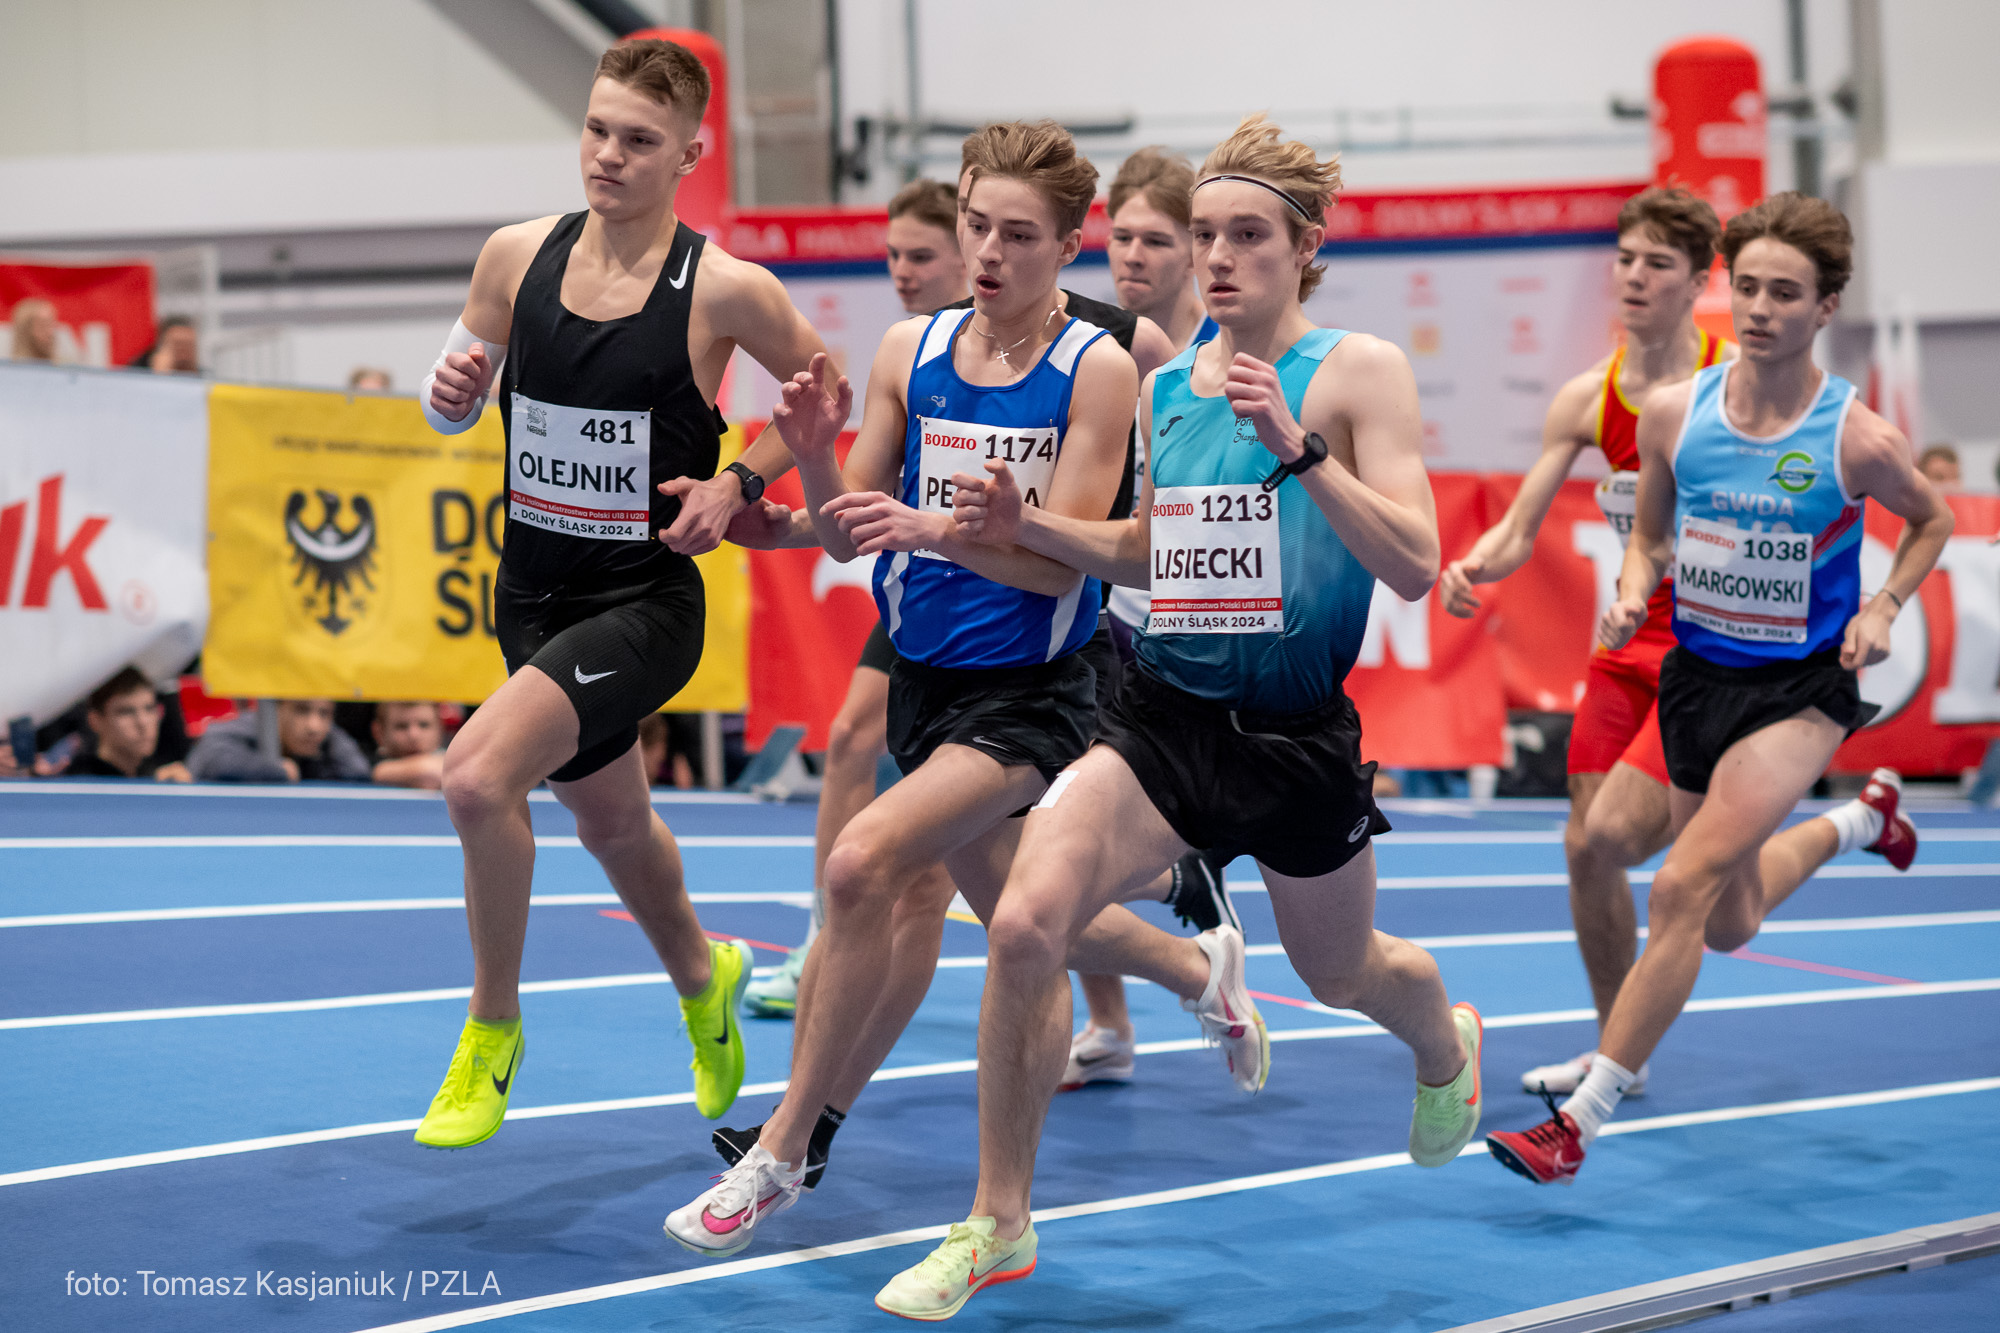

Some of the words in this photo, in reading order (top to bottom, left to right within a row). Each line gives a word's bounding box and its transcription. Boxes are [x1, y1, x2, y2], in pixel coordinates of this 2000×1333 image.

[580, 418, 636, 445] 481
[924, 433, 977, 451] BODZIO
[985, 434, 1054, 463] 1174
[519, 451, 637, 494] OLEJNIK
[548, 504, 588, 517] Mistrzostwa
[589, 511, 611, 519] Polski
[1152, 503, 1194, 517] BODZIO
[1201, 494, 1273, 523] 1213
[1711, 491, 1794, 517] GWDA
[521, 509, 556, 527] DOLNY
[559, 516, 597, 535] ŚLĄSK
[600, 525, 632, 536] 2024
[1685, 528, 1736, 550] BODZIO
[1743, 538, 1807, 562] 1038
[1155, 547, 1263, 580] LISIECKI
[1680, 562, 1803, 604] MARGOWSKI
[1177, 602, 1219, 610] Mistrzostwa
[1220, 601, 1240, 609] Polski
[1242, 601, 1255, 609] U18
[1153, 617, 1185, 628] DOLNY
[1188, 614, 1229, 630] ŚLĄSK
[1231, 616, 1265, 628] 2024
[1764, 628, 1793, 638] 2024
